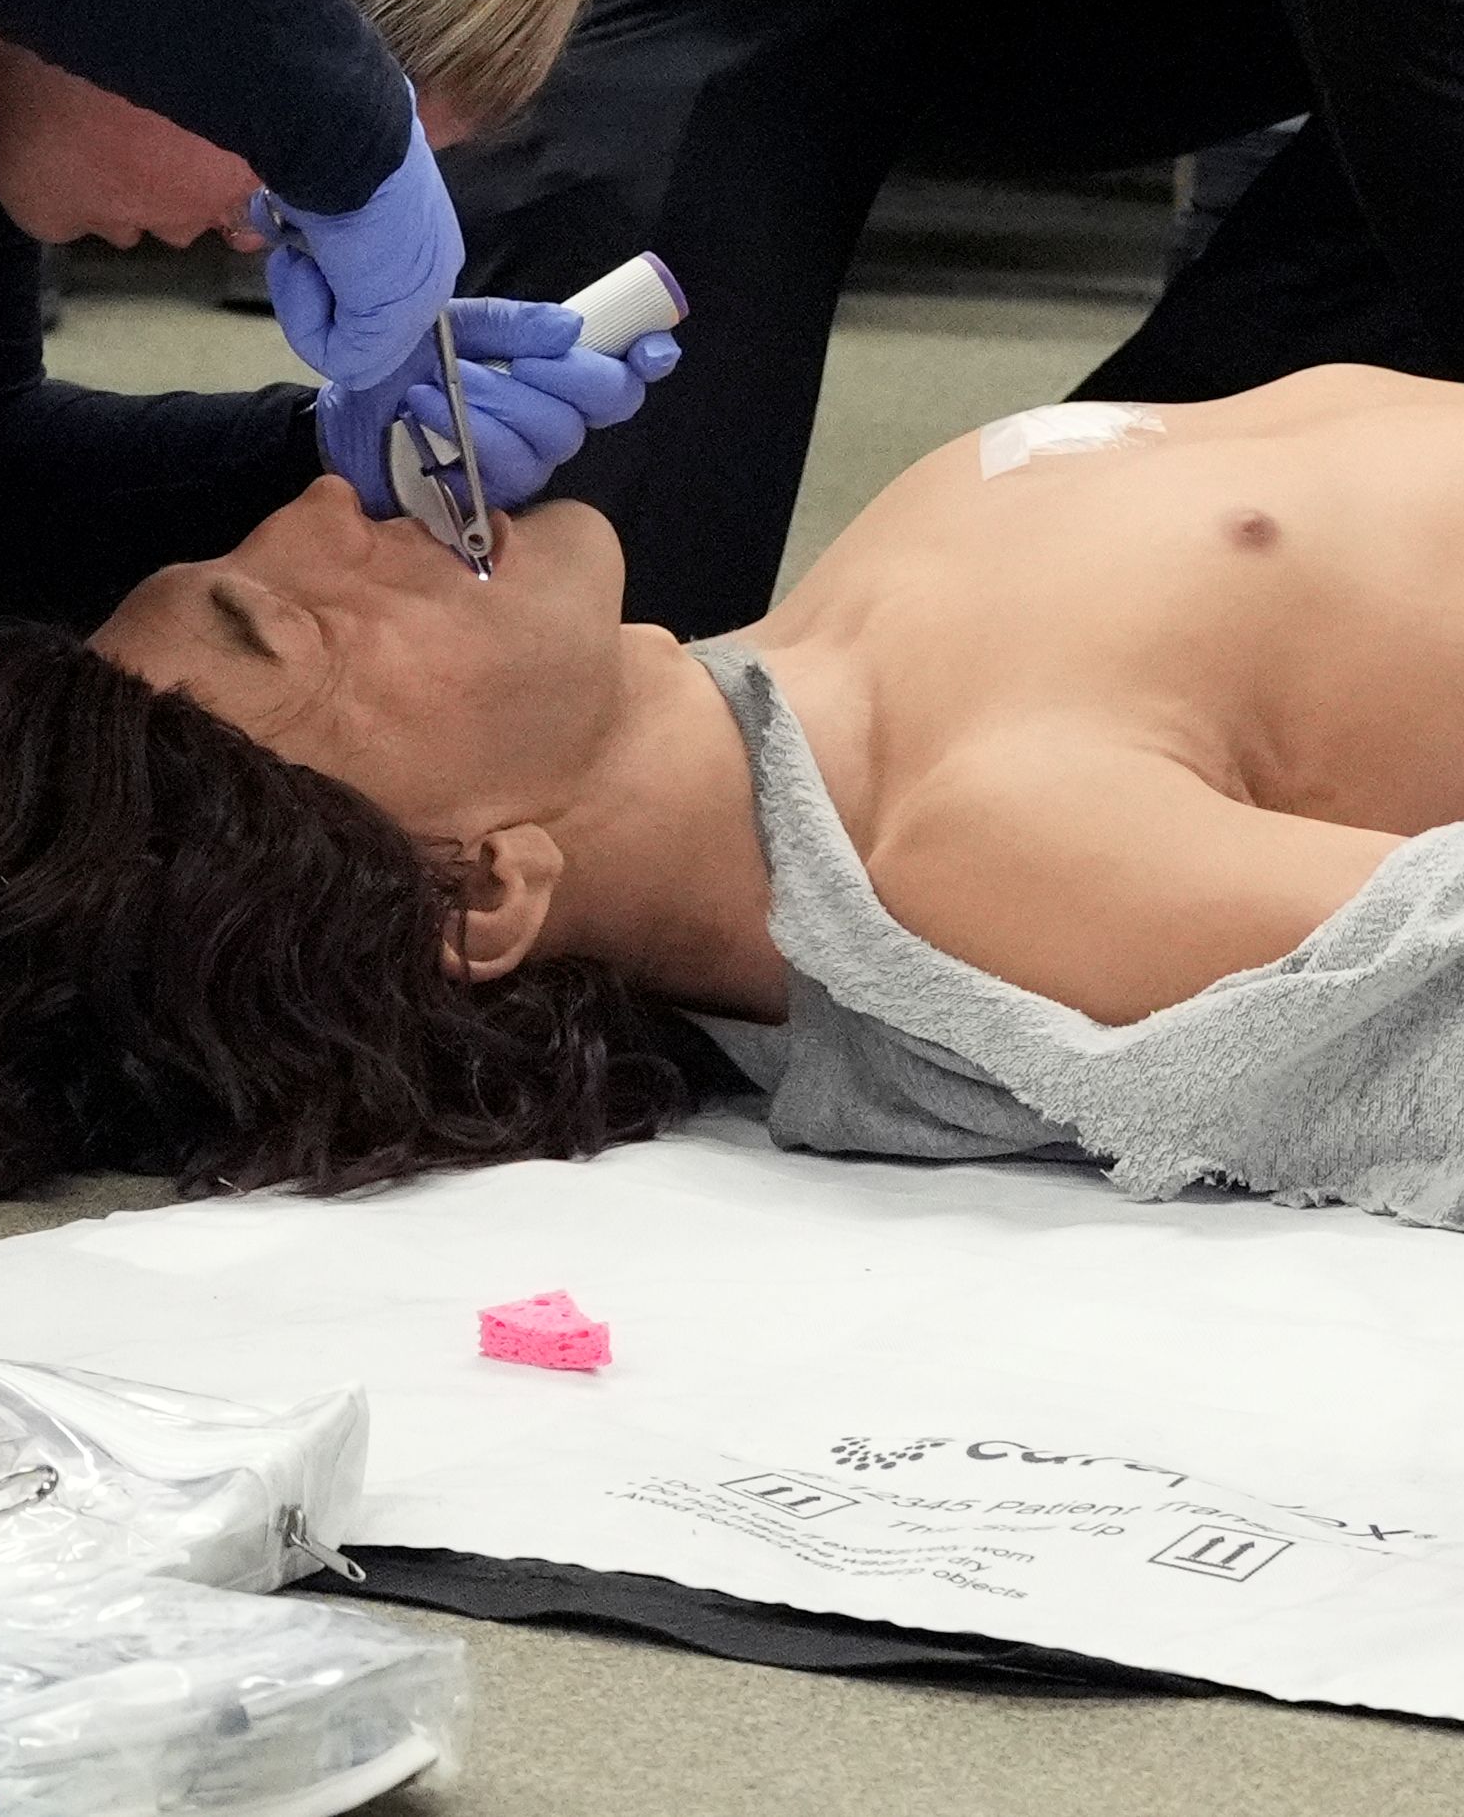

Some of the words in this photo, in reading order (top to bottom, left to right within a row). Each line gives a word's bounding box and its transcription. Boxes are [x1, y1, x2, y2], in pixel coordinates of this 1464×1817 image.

[663, 1479, 702, 1493] Do
[984, 1498, 1142, 1517] Patient
[641, 1483, 680, 1497] Do
[947, 1555, 993, 1574] dry
[1069, 1520, 1127, 1537] Up
[932, 1569, 1030, 1600] objects
